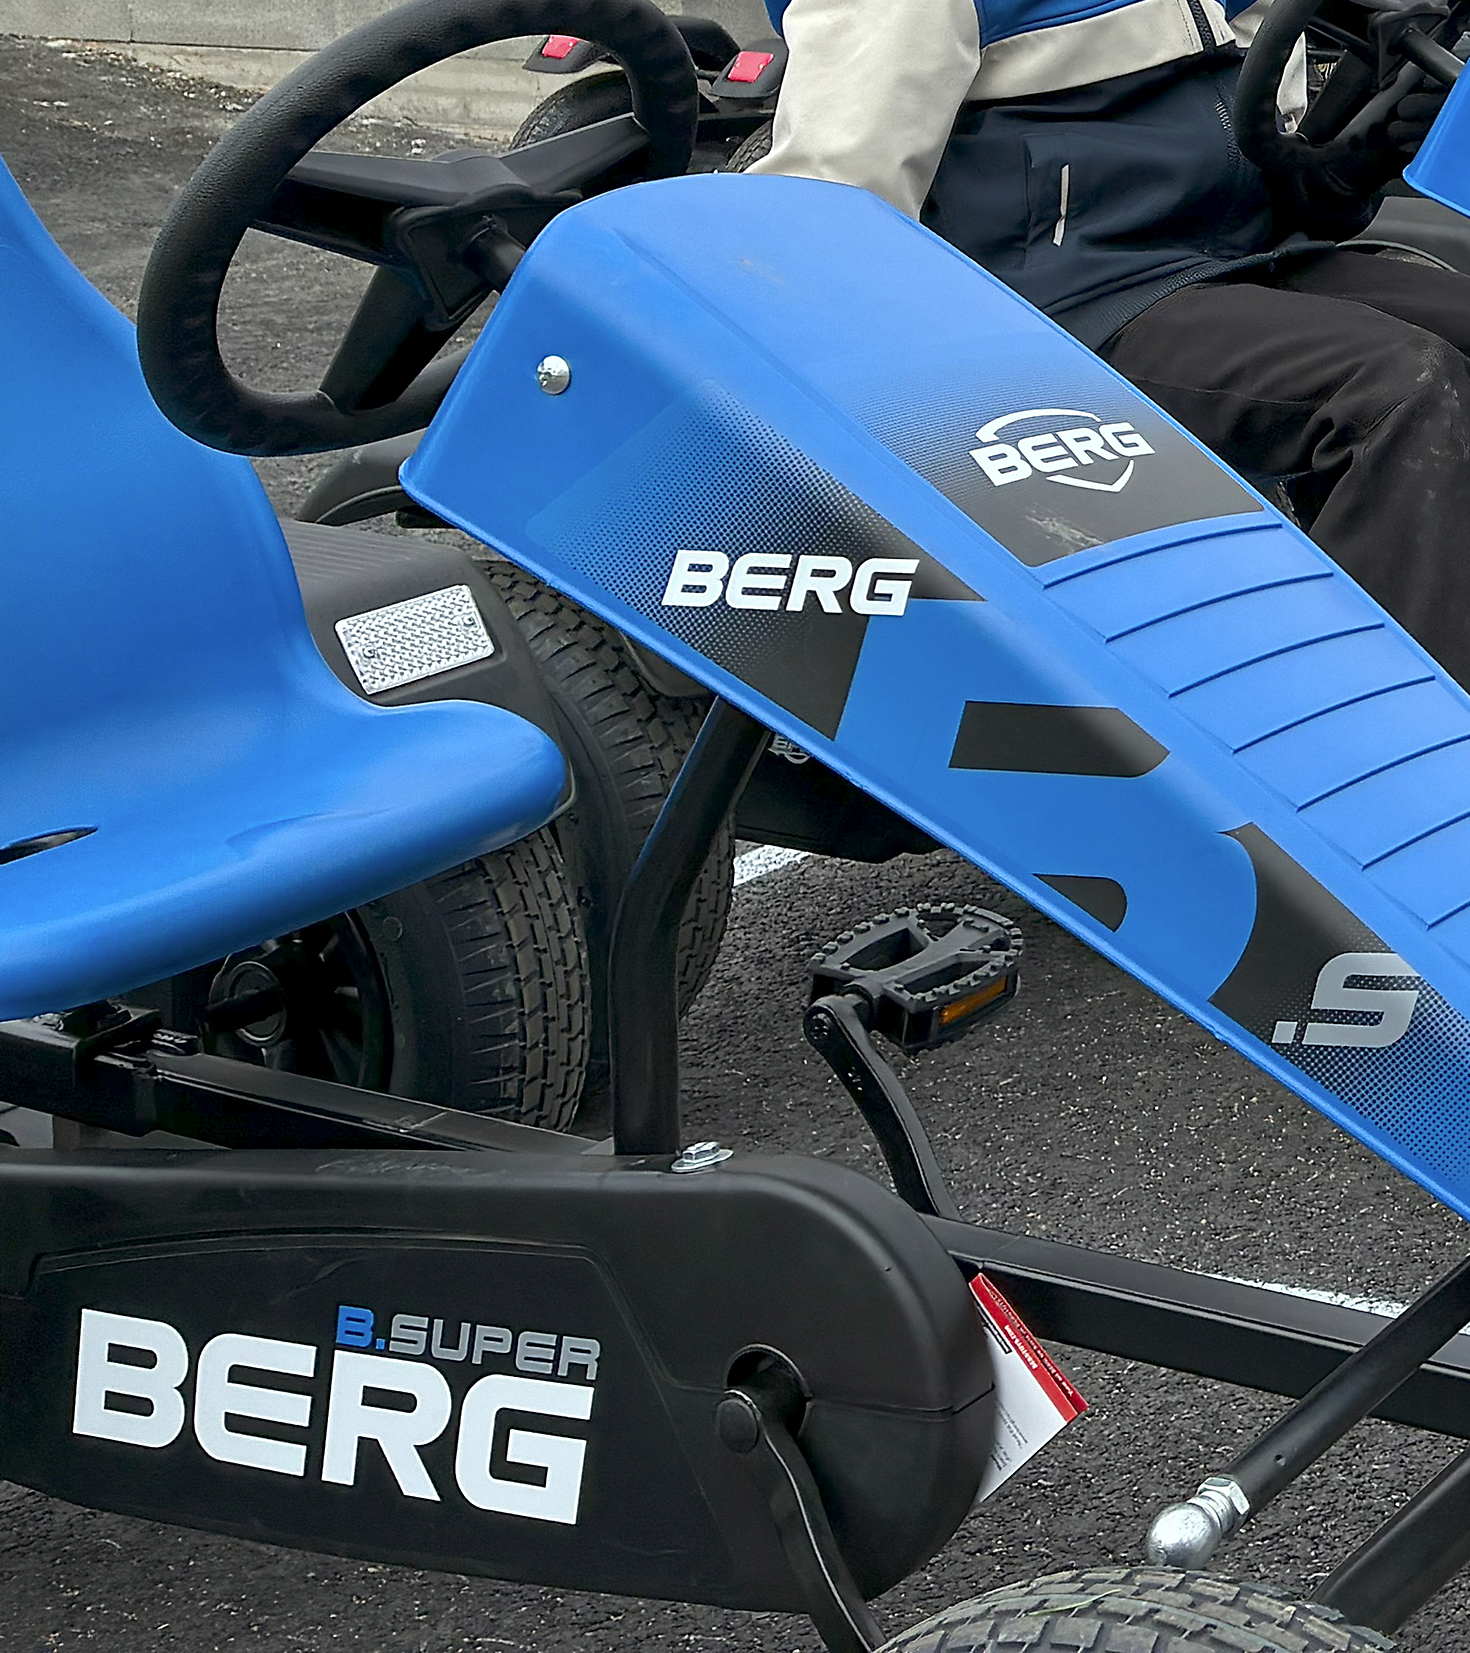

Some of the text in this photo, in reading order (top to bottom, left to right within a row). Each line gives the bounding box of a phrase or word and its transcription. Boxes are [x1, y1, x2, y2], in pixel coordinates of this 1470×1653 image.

[968, 420, 1155, 488] BERG
[661, 549, 920, 616] BERG
[335, 1305, 600, 1380] B.SUPER
[73, 1308, 595, 1526] BERG
